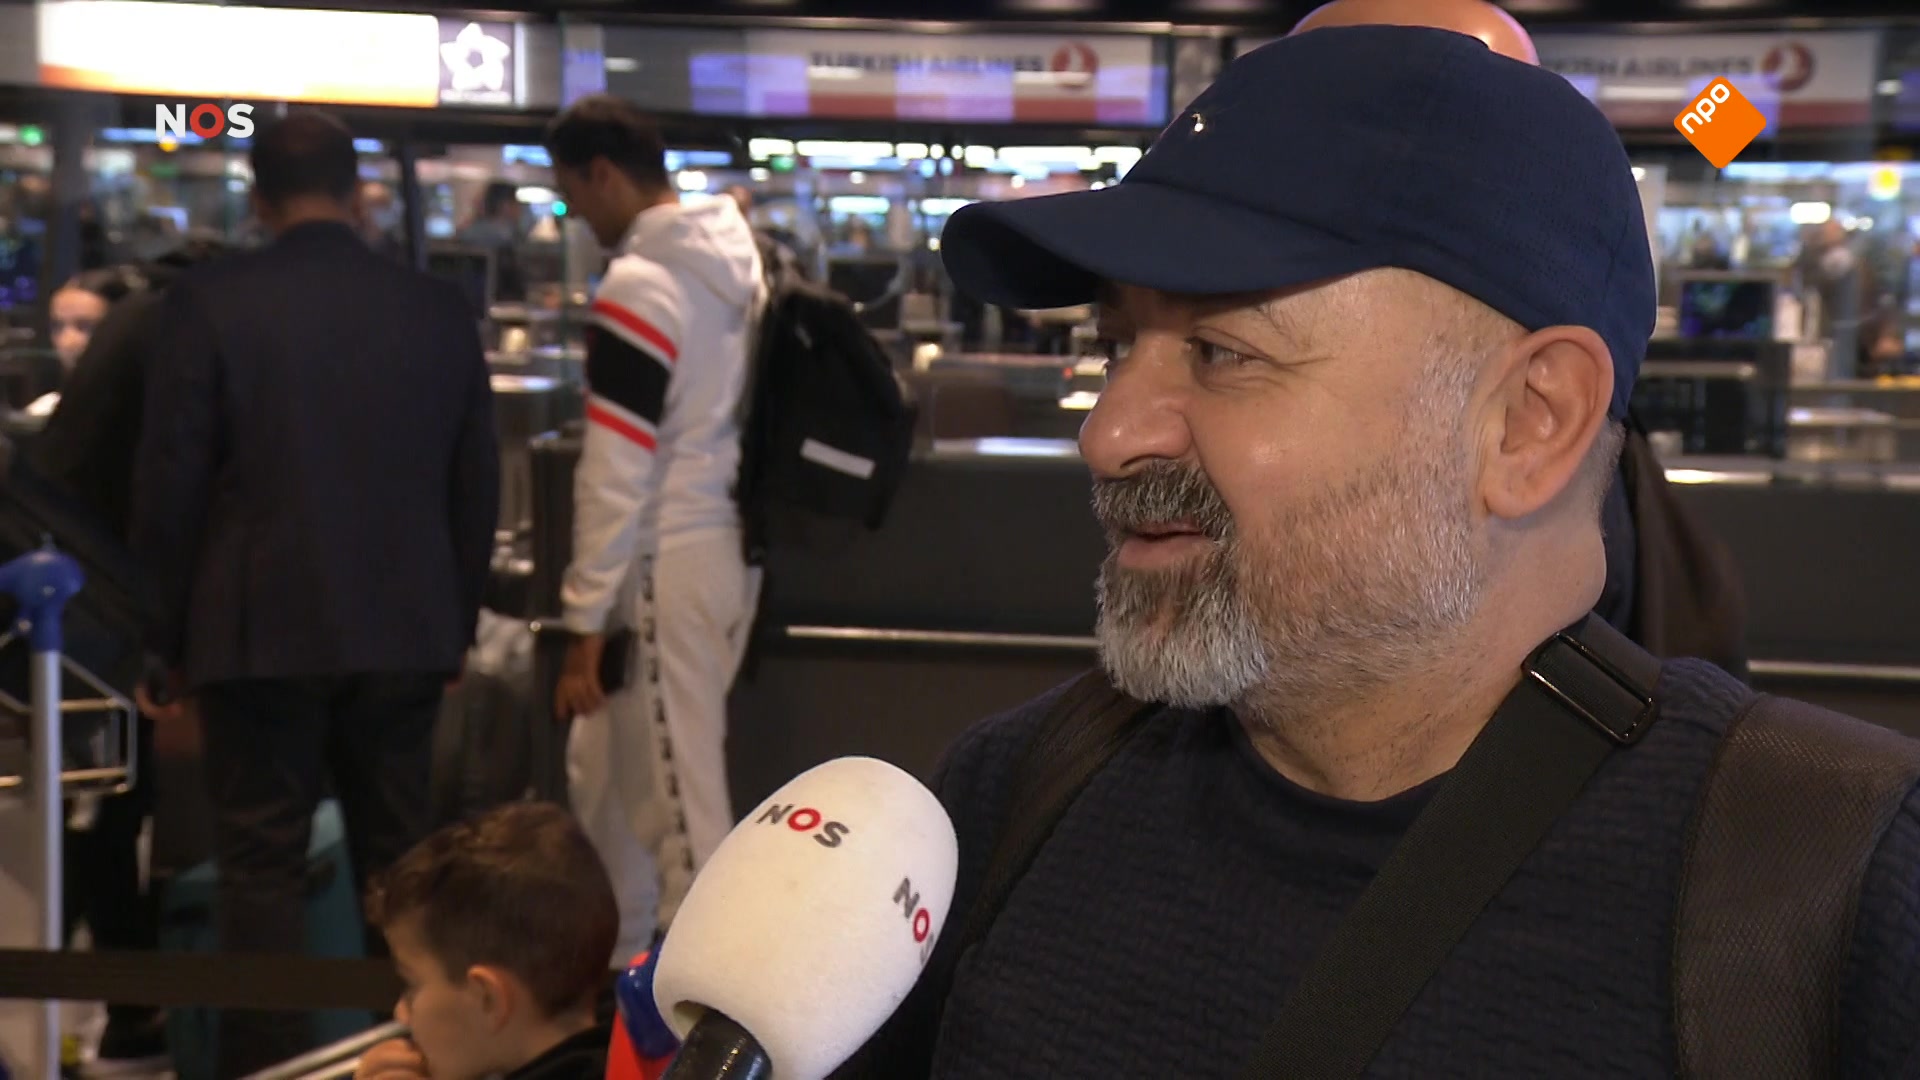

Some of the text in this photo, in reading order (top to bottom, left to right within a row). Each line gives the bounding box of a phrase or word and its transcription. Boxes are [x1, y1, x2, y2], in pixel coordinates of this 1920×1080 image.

[810, 51, 1043, 74] TURKISH AIRLINES
[755, 803, 850, 849] NOS
